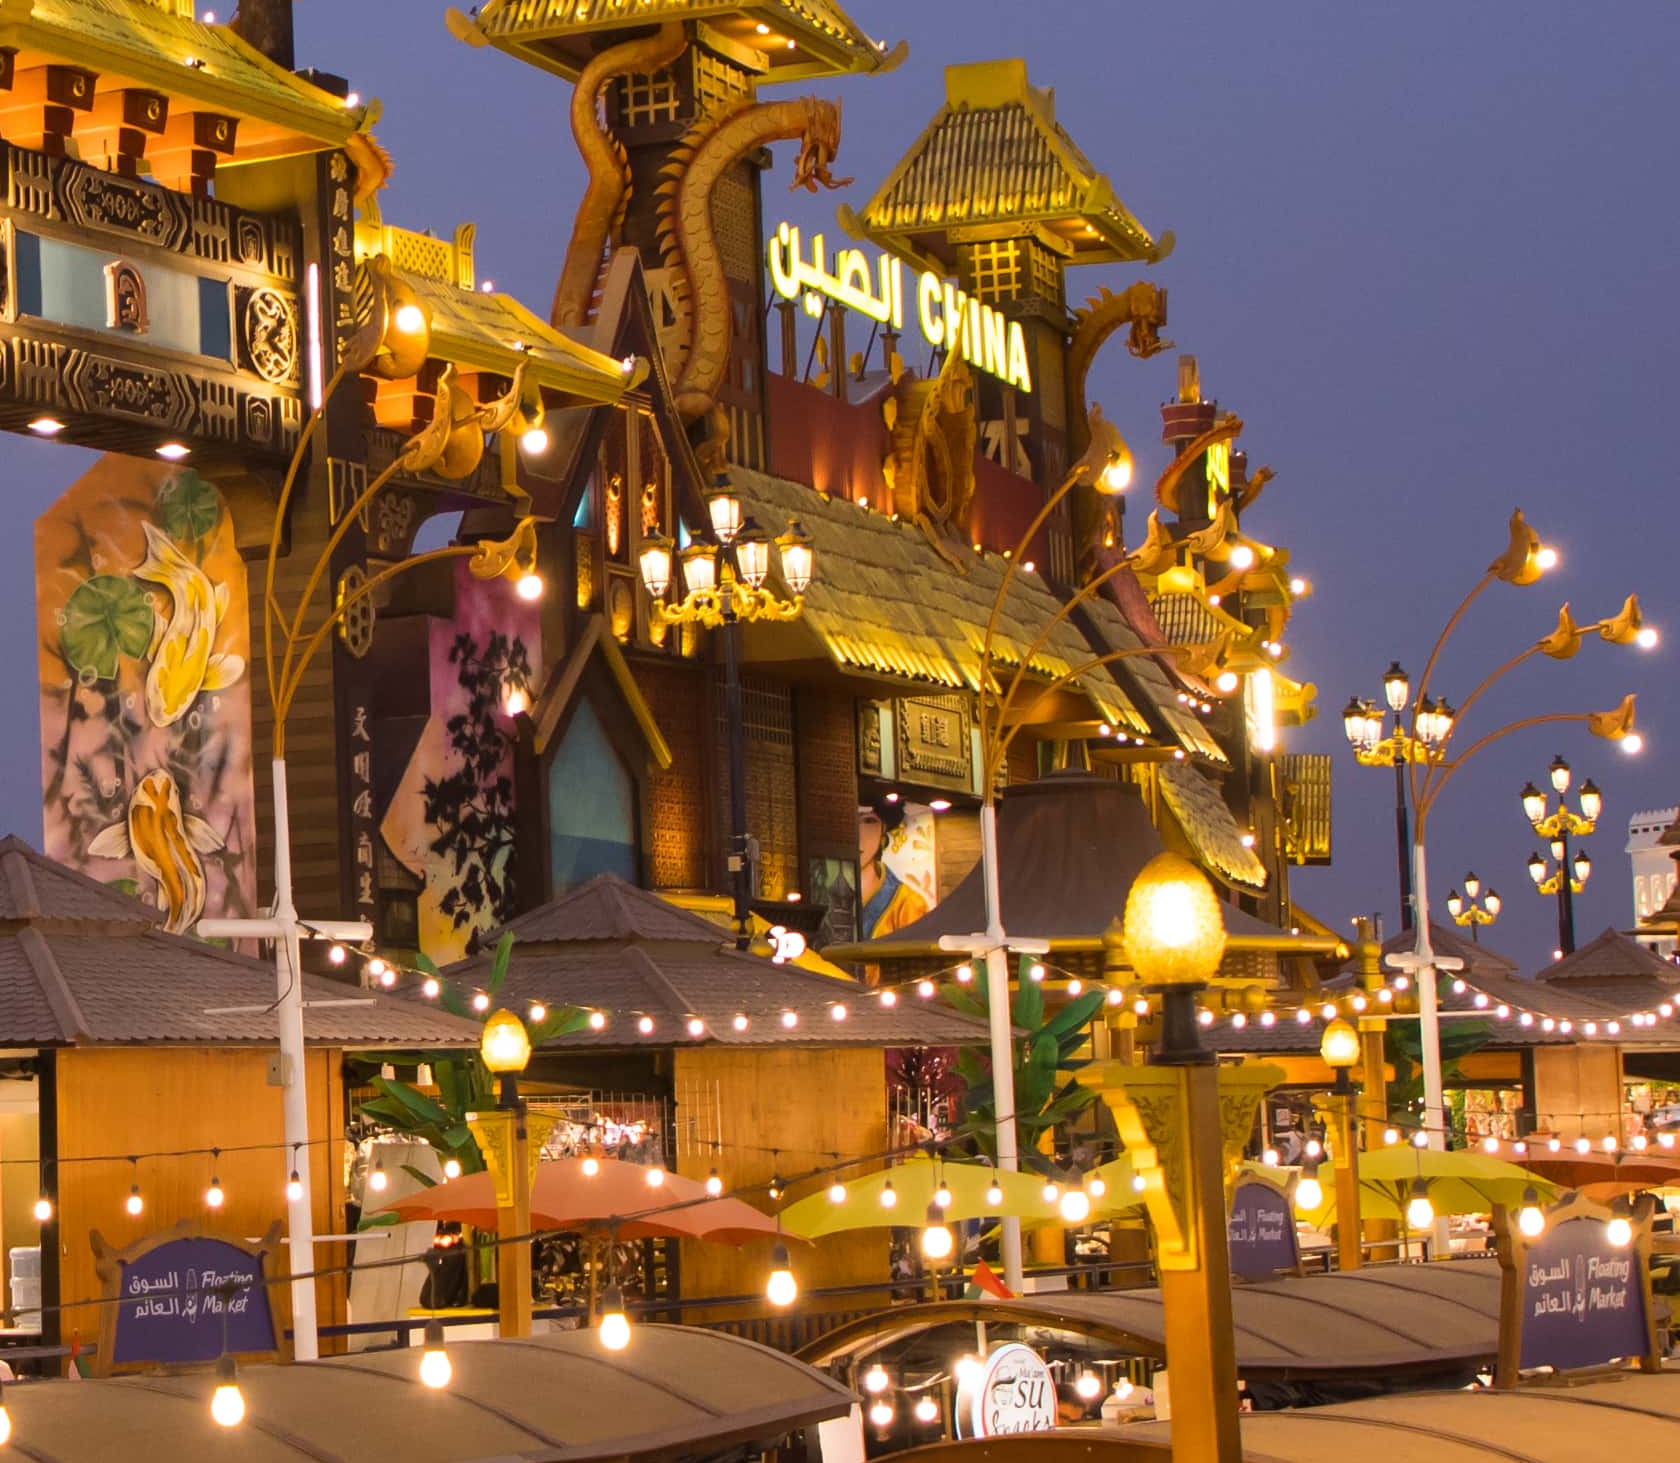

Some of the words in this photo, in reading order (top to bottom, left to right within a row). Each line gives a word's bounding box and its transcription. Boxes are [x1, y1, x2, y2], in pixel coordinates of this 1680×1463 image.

[769, 221, 904, 329] الصين
[918, 271, 1032, 393] CHINA
[129, 1271, 179, 1294] السوق
[1529, 1258, 1570, 1287] السوق
[1587, 1256, 1630, 1283] Floating
[135, 1297, 179, 1319] العائم
[202, 1294, 249, 1315] Maket
[1589, 1285, 1626, 1311] Market
